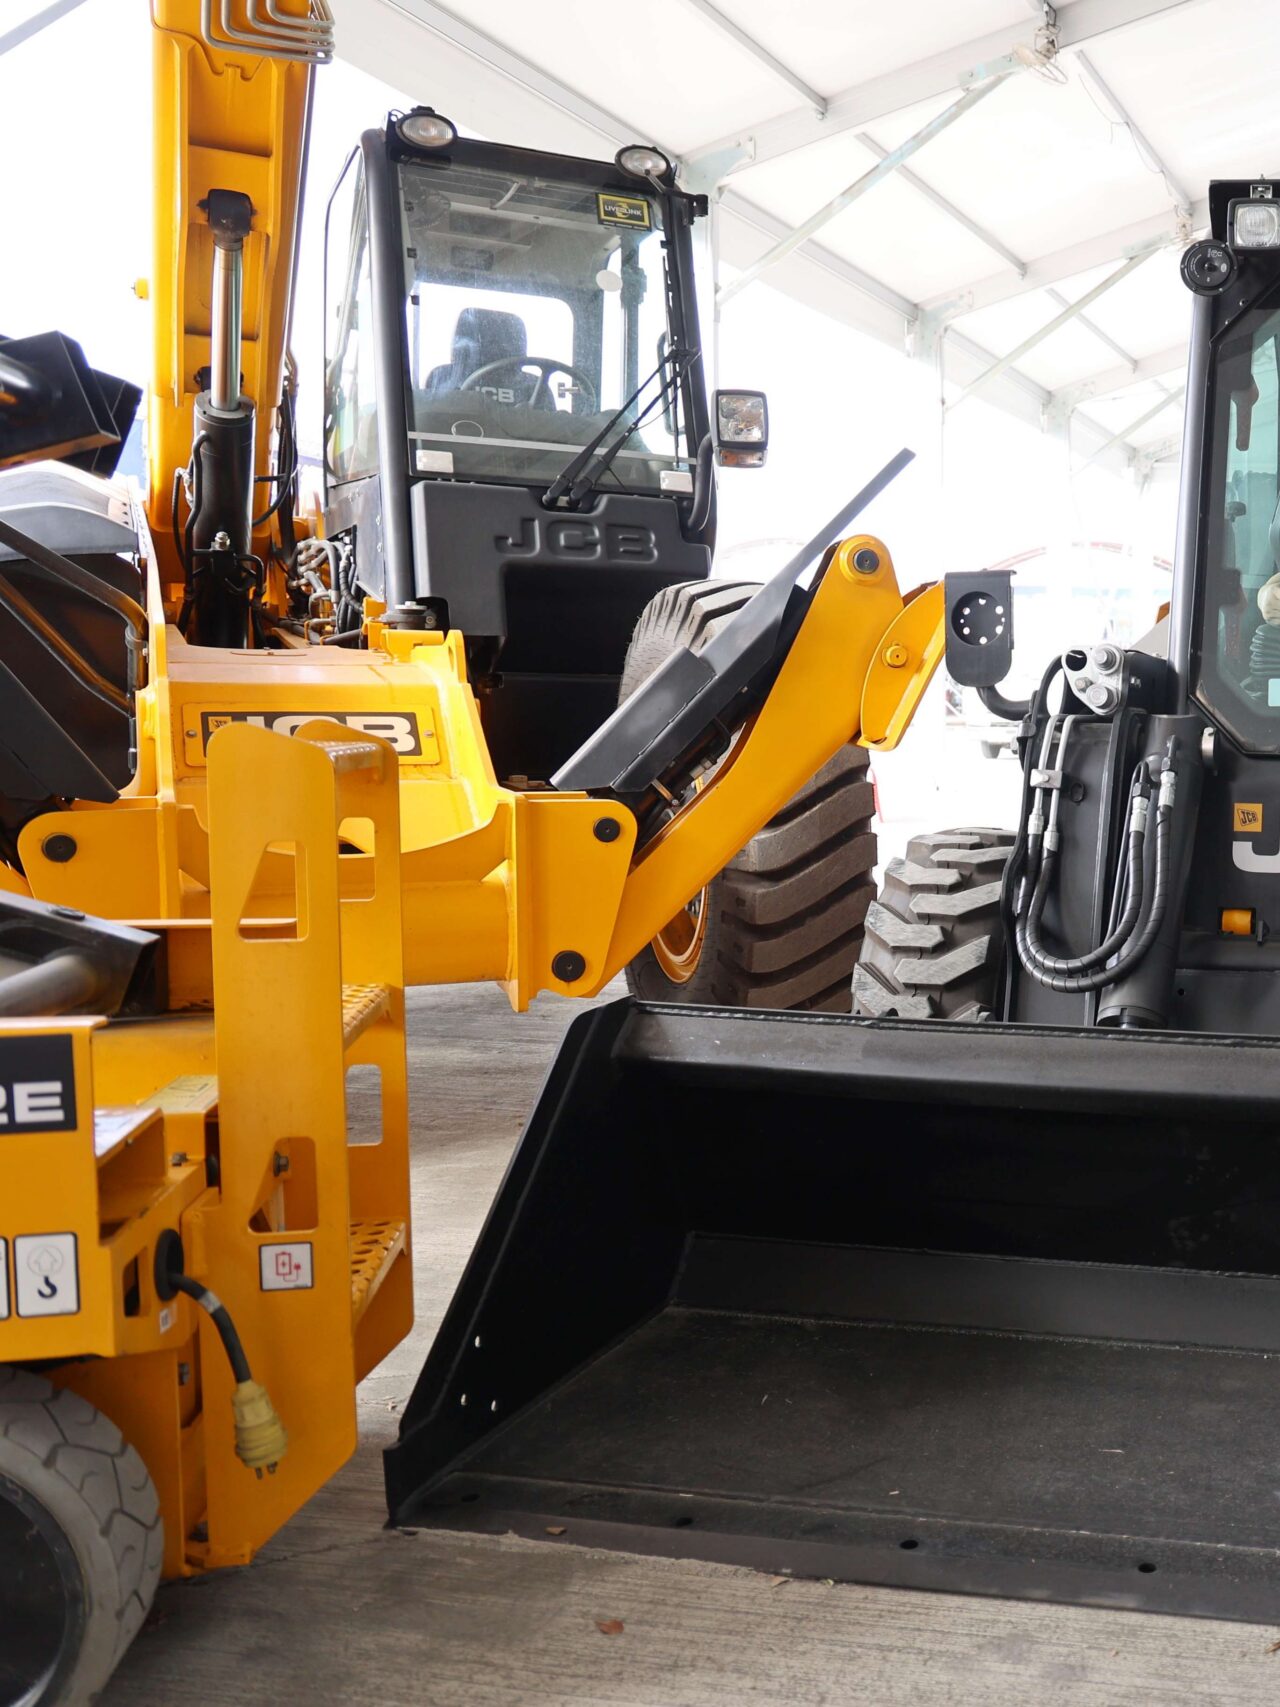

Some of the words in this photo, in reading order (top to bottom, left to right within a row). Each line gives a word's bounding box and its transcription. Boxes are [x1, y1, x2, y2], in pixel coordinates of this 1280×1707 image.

[475, 386, 515, 403] CB
[494, 517, 659, 564] JCB
[1240, 808, 1258, 824] JCB
